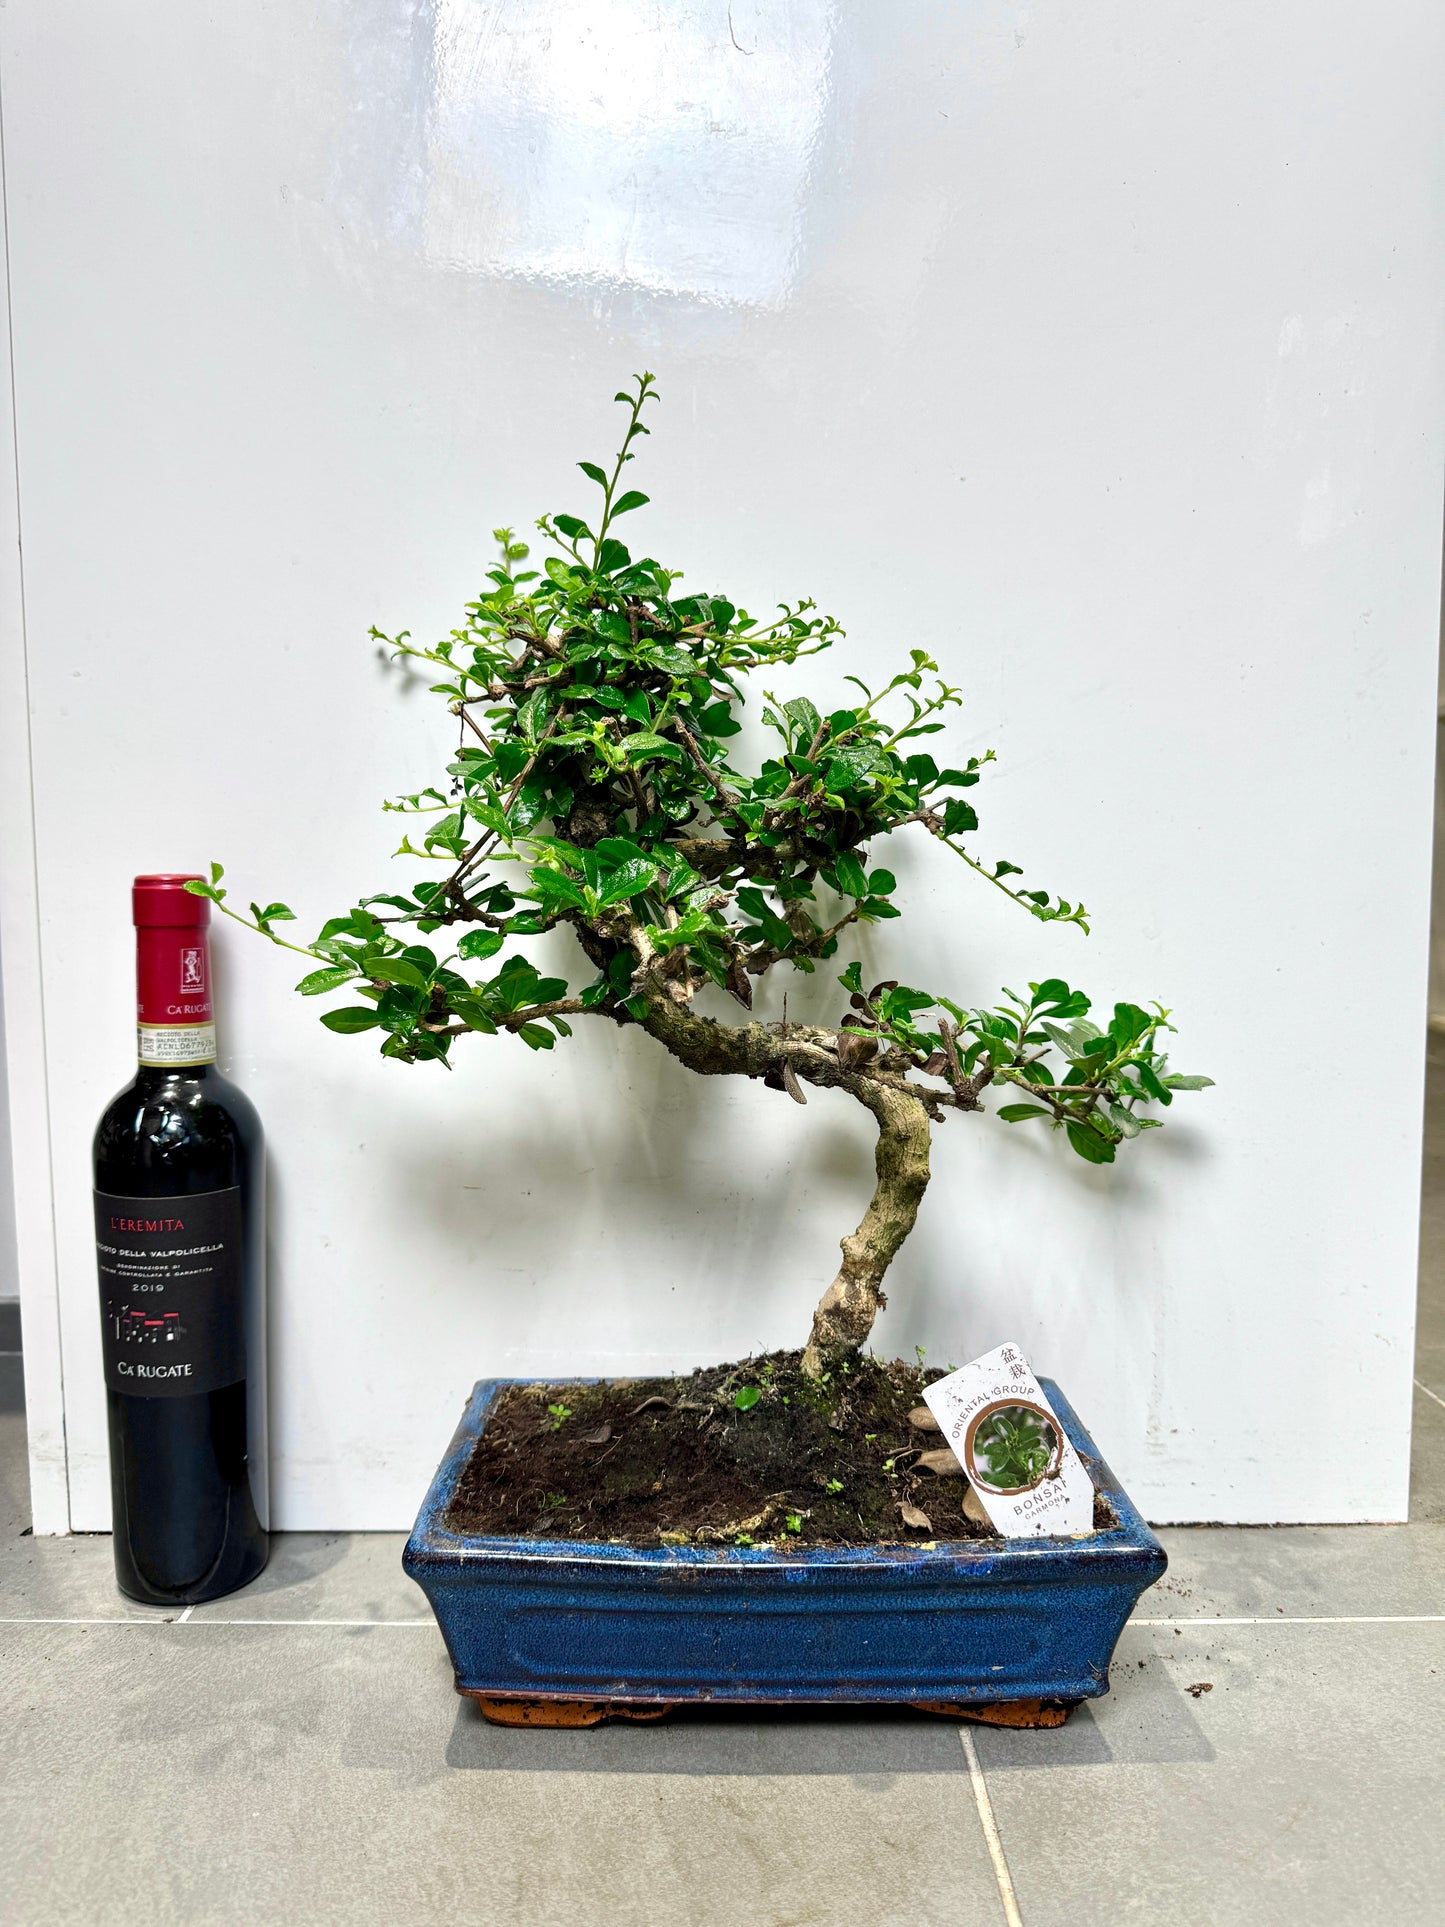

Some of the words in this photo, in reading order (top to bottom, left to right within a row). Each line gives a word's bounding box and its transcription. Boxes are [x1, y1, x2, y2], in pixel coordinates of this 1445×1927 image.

[110, 1217, 184, 1232] L'EREMITA
[119, 1249, 146, 1257] DELLA
[150, 1243, 224, 1257] VALPOLICELLA
[118, 1270, 162, 1278] CONTROLLATA
[174, 1267, 213, 1277] GARANTITA
[131, 1283, 165, 1292] 2019
[137, 1363, 193, 1378] RUGATE
[1001, 1348, 1027, 1380] 盆栽
[952, 1391, 991, 1439] ORIENTAL
[993, 1385, 1035, 1396] GROUP
[1025, 1494, 1067, 1520] CARMONA
